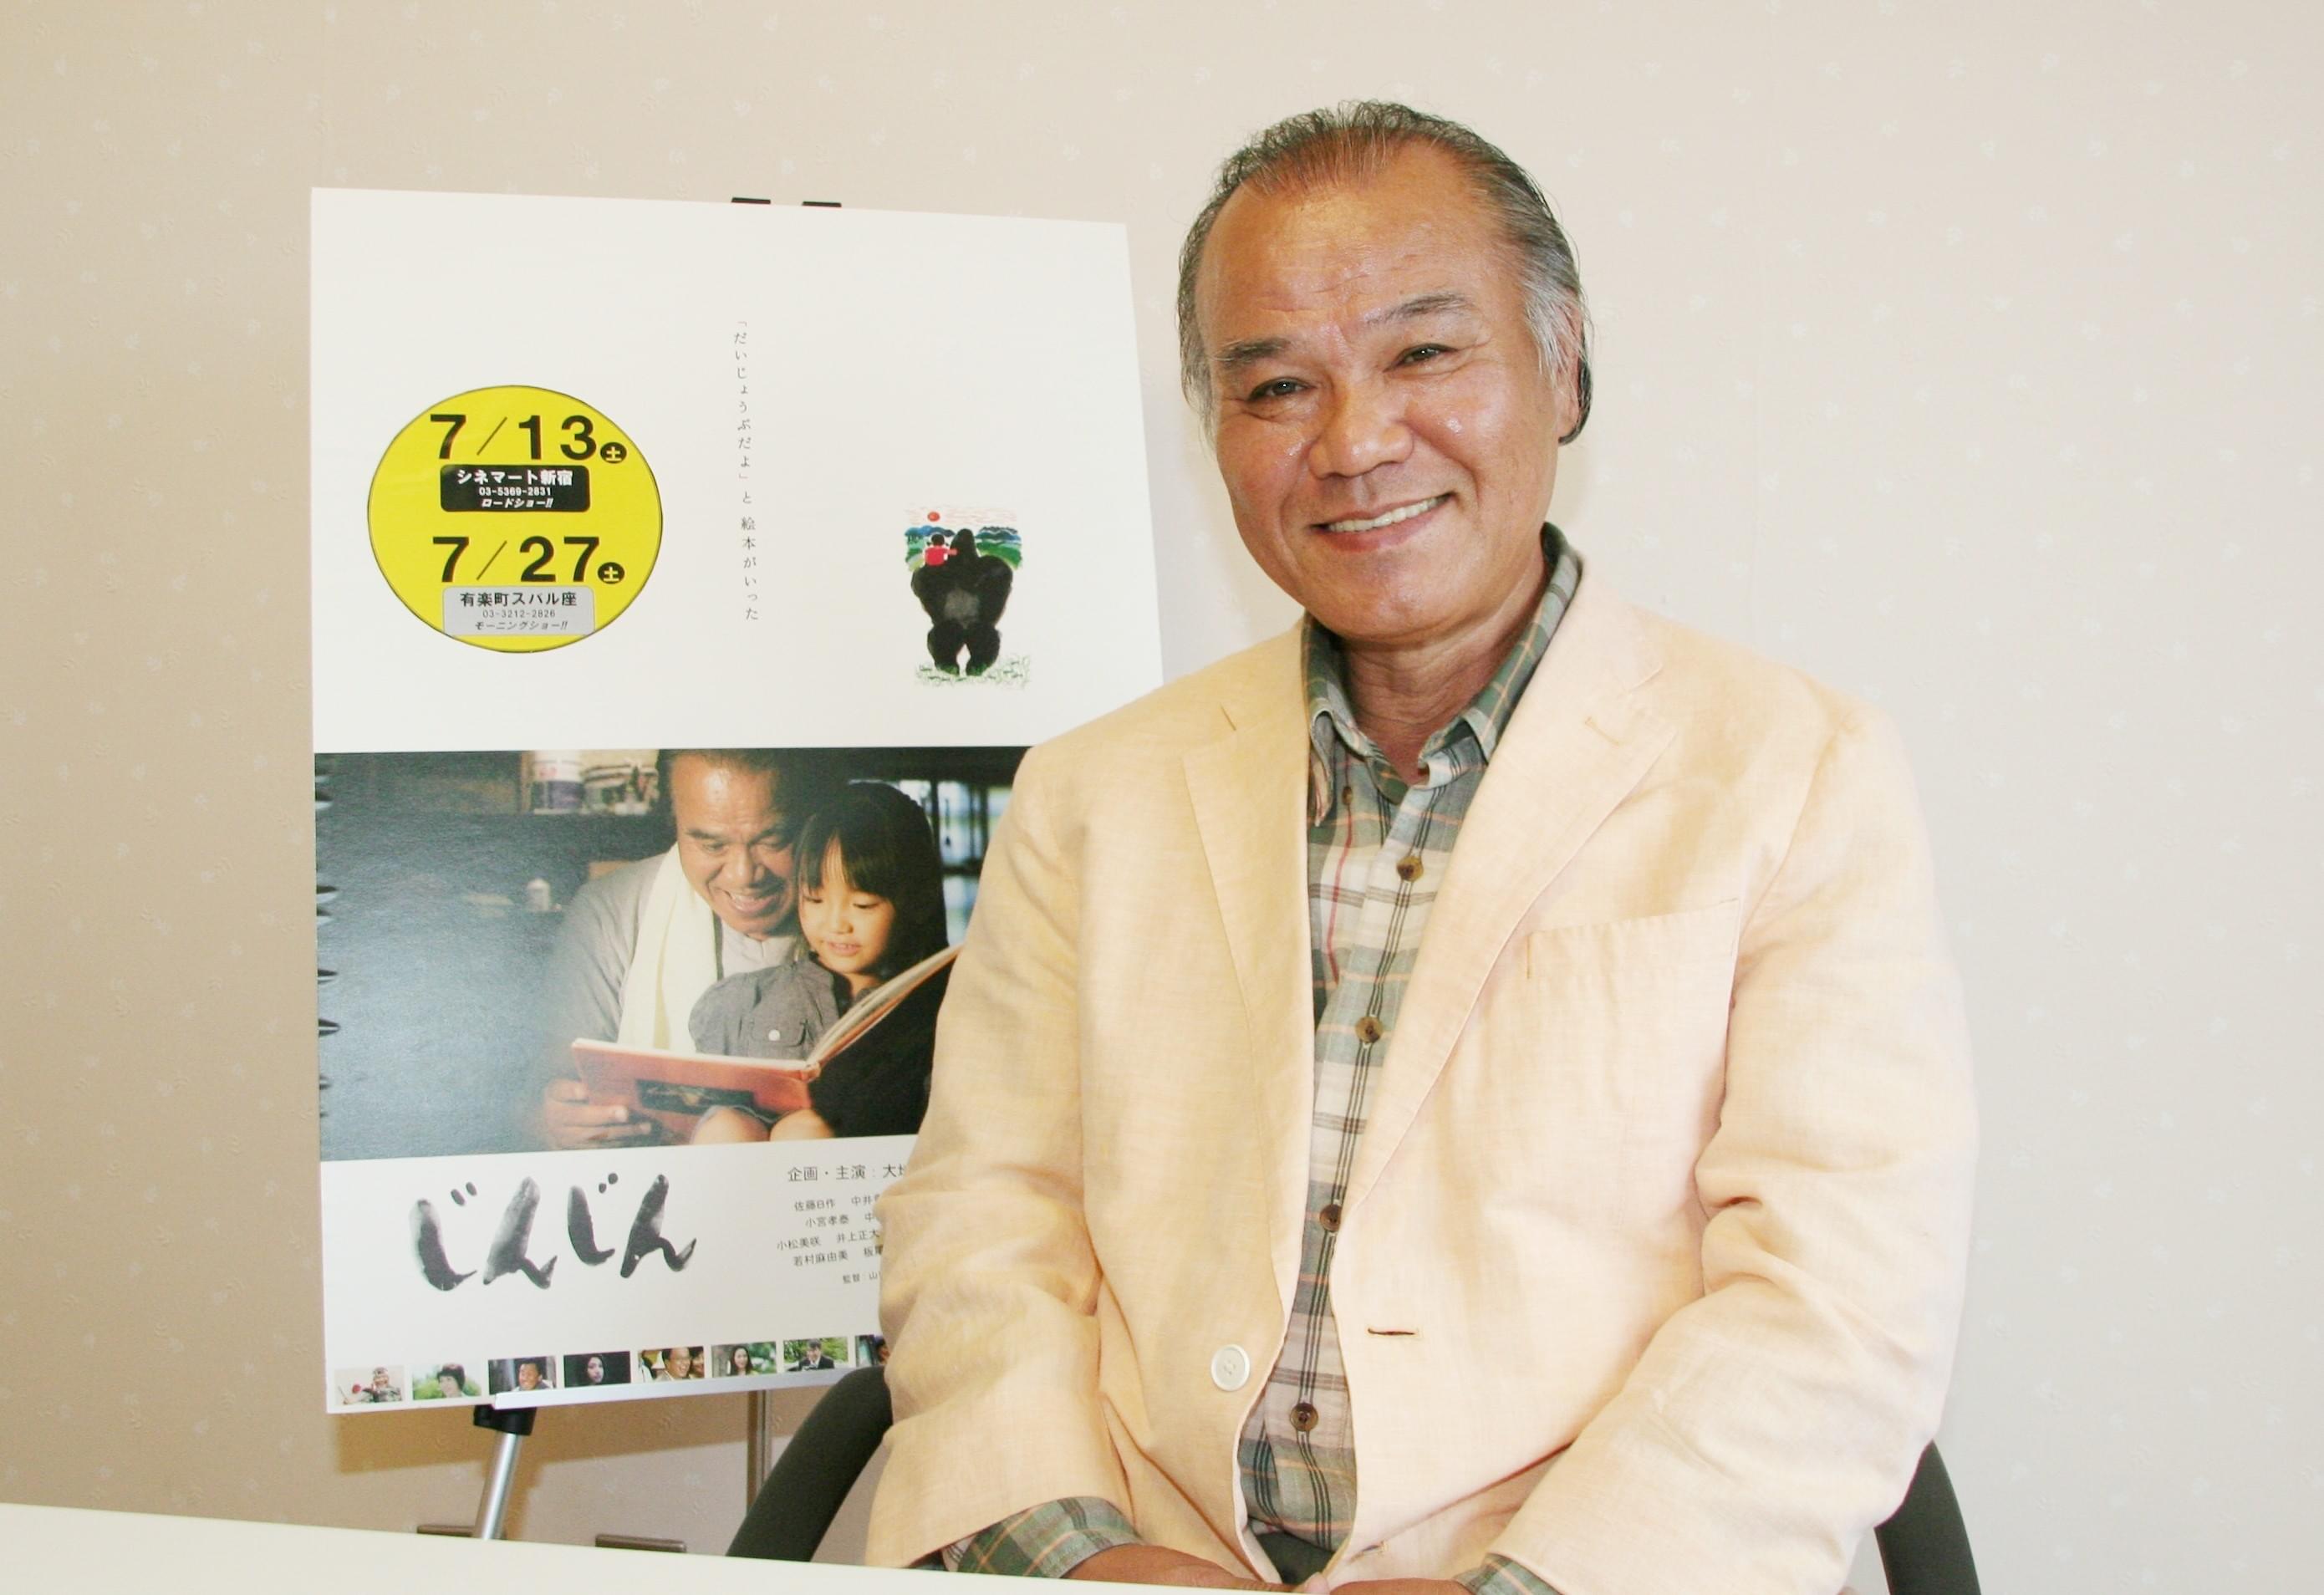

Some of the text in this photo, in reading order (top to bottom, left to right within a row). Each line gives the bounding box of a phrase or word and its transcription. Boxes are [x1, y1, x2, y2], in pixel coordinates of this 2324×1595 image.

[456, 469, 574, 486] シネマート新宿
[460, 592, 578, 607] 有楽町スバル座
[482, 609, 556, 618] 03-3212-2826
[407, 1172, 697, 1292] じんじん
